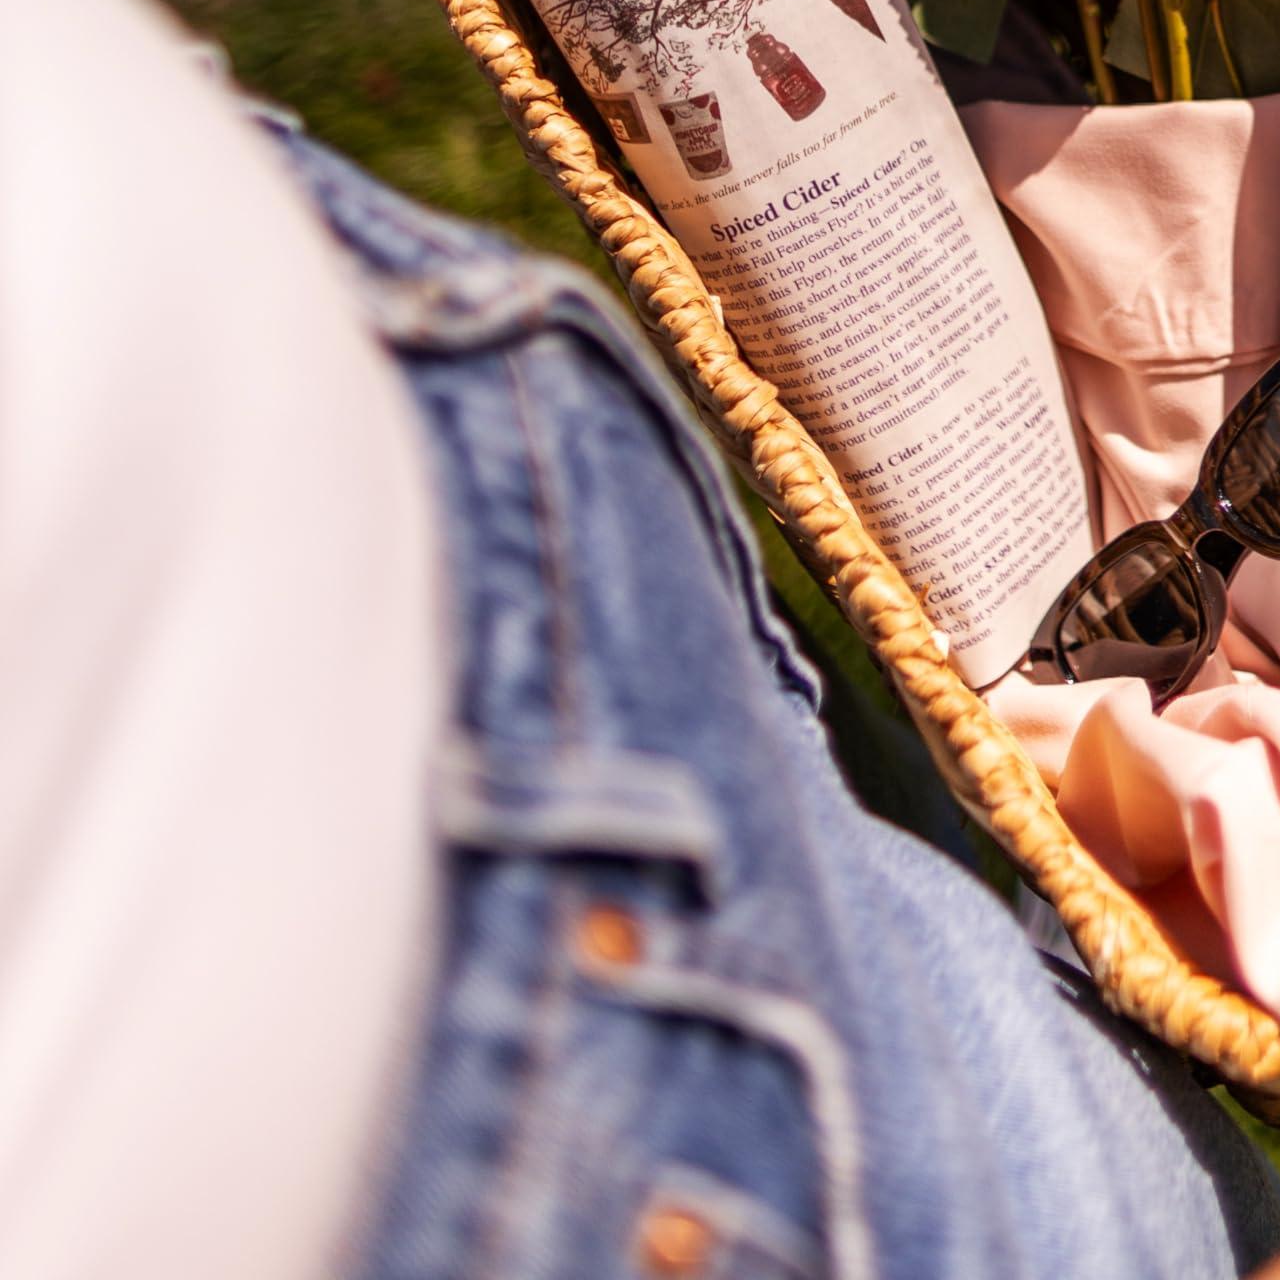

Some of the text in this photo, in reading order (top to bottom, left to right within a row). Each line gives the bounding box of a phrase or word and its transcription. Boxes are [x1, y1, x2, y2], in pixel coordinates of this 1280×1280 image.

[693, 192, 711, 206] the
[710, 180, 742, 201] value
[742, 166, 774, 188] never
[774, 150, 801, 173] falls
[801, 139, 822, 158] too
[820, 128, 839, 147] far
[838, 113, 863, 137] from
[862, 102, 879, 120] the
[724, 237, 765, 262] you're
[872, 149, 908, 183] Cider?
[909, 136, 928, 155] On
[709, 170, 843, 247] Spiced Cider
[720, 264, 736, 278] of
[732, 261, 752, 275] the
[750, 250, 777, 270] Fall
[775, 226, 828, 260] Fearless
[826, 202, 866, 235] Flyer?
[864, 191, 885, 211] It's
[889, 174, 907, 193] bit
[904, 167, 919, 182] on
[916, 153, 935, 172] the
[746, 168, 942, 291] can't help ourselves. In our book (or
[752, 294, 768, 307] in
[767, 285, 792, 303] this
[837, 251, 859, 269] the
[860, 228, 895, 257] return
[894, 215, 908, 233] of
[907, 202, 928, 223] this
[760, 299, 807, 325] nothing
[805, 282, 839, 307] short
[838, 272, 854, 290] of
[853, 230, 919, 283] newsworthy.
[918, 199, 959, 236] Brewed
[761, 327, 776, 342] of
[775, 270, 894, 339] bursting-with-flavor
[895, 243, 933, 276] apples,
[932, 215, 966, 247] spiced
[771, 334, 821, 358] allspice,
[818, 320, 843, 342] and
[842, 298, 887, 331] cloves,
[884, 281, 906, 304] and
[904, 247, 950, 290] anchored
[948, 231, 971, 255] with
[775, 358, 807, 374] citrus
[805, 353, 824, 367] on
[822, 342, 844, 360] the
[843, 320, 884, 351] finish,
[880, 310, 897, 327] its
[895, 279, 942, 317] coziness
[949, 261, 963, 277] on
[801, 372, 818, 387] of
[816, 365, 838, 382] the
[838, 343, 881, 372] season
[880, 317, 917, 350] (we're
[954, 280, 966, 296] at
[804, 385, 835, 403] wool
[834, 358, 890, 395] scarves).
[888, 349, 904, 365] In
[926, 322, 941, 337] in
[940, 303, 968, 328] some
[967, 280, 995, 307] states
[822, 402, 838, 418] of
[850, 372, 900, 407] mindset
[900, 354, 926, 378] than
[936, 321, 972, 352] season
[971, 310, 984, 326] at
[982, 295, 1002, 316] this
[838, 432, 868, 453] your
[867, 386, 942, 441] (unmittened)
[939, 365, 969, 393] mitts.
[855, 392, 901, 424] doesn't
[900, 375, 927, 399] start
[925, 355, 951, 382] until
[843, 461, 886, 487] Spiced
[886, 440, 925, 468] Cider
[926, 431, 939, 445] is
[940, 413, 962, 435] new
[963, 400, 977, 417] to
[864, 480, 890, 498] that
[891, 473, 905, 486] it
[907, 441, 955, 479] contains
[956, 428, 971, 446] no
[971, 400, 1004, 431] added
[906, 484, 921, 499] or
[914, 489, 948, 515] alone
[948, 479, 962, 495] or
[961, 440, 1010, 485] alongside
[903, 513, 943, 541] makes
[945, 502, 961, 518] an
[908, 525, 957, 558] Another
[940, 534, 973, 561] value
[927, 581, 965, 606] Cider
